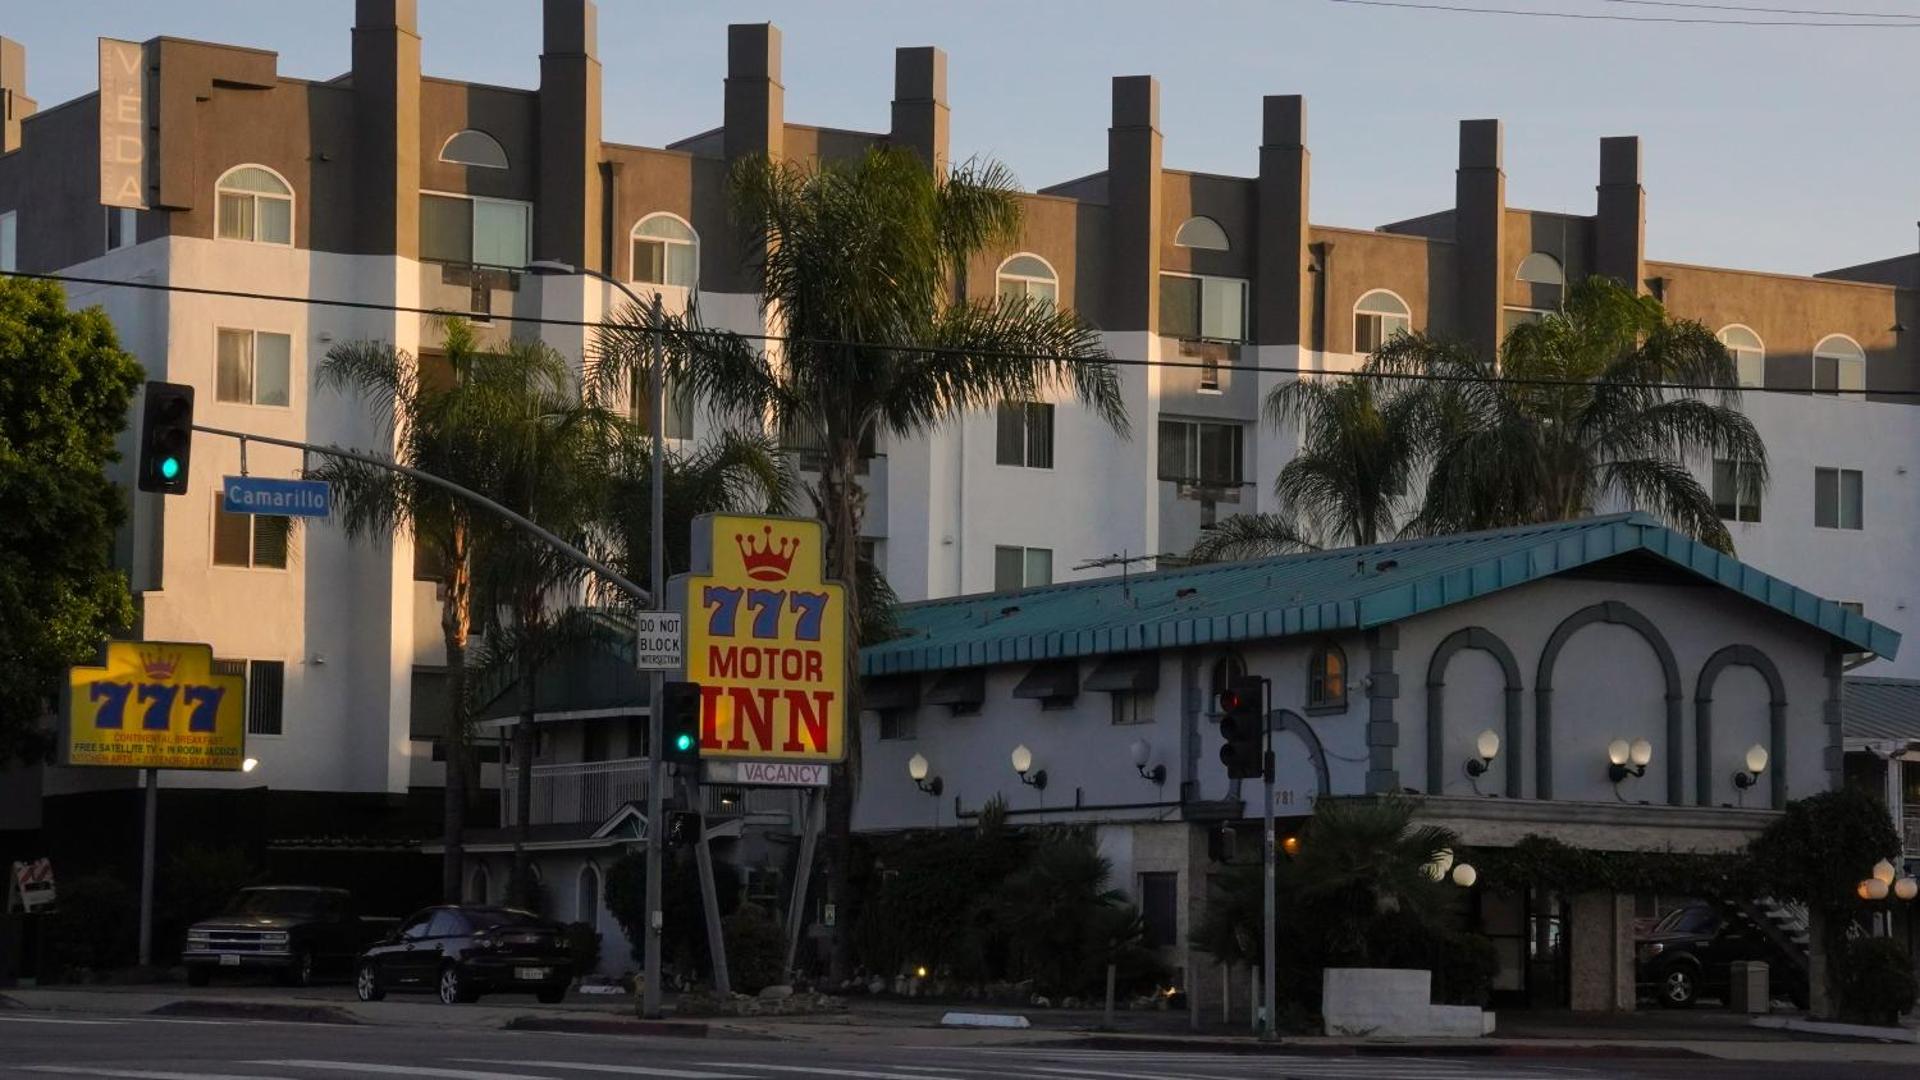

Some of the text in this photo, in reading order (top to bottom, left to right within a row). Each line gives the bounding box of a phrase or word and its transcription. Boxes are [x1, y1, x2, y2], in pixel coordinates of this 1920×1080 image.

[229, 485, 324, 508] Camarillo
[703, 585, 830, 642] 777
[641, 619, 680, 633] DO NOT
[641, 638, 680, 652] BLOCK
[642, 655, 680, 665] INTERSECTION
[709, 645, 823, 682] MOTOR
[90, 681, 226, 732] 777
[699, 685, 835, 753] INN
[114, 733, 171, 744] CONTINENTAL
[74, 743, 100, 752] FREE
[101, 743, 145, 754] SATELLITE
[146, 745, 158, 754] TV
[177, 745, 203, 755] ROOM
[744, 764, 822, 783] VACANCY
